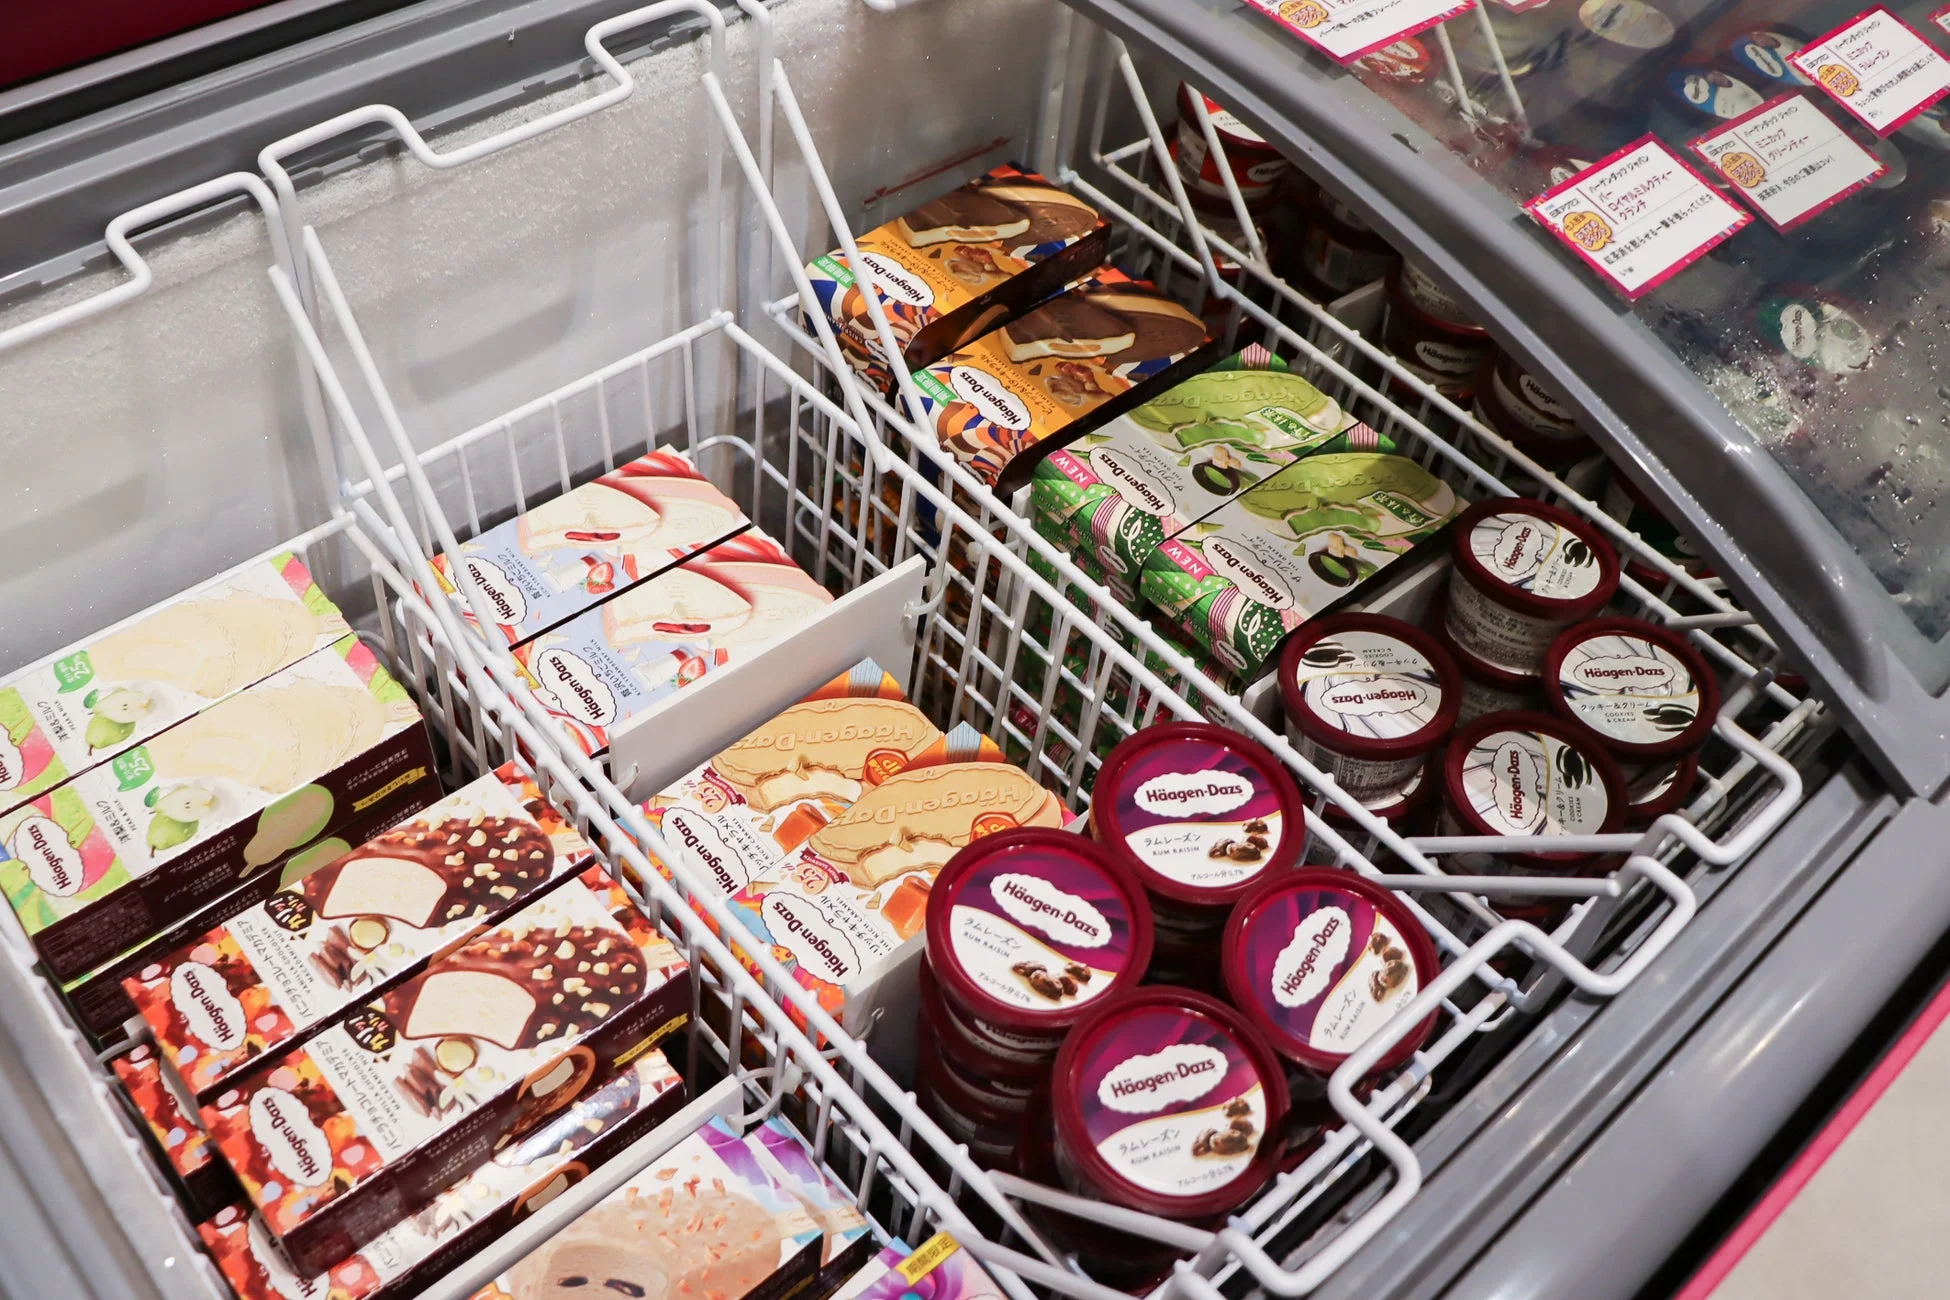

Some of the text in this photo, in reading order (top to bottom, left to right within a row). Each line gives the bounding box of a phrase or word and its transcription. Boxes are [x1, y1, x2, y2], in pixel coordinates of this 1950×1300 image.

[1755, 127, 1787, 150] ミニカップ
[1768, 134, 1810, 162] グリーンティー
[1607, 168, 1674, 213] ロイヤルミルクティー
[1618, 198, 1648, 222] クランチ
[816, 255, 853, 286] 期間限定
[861, 254, 926, 304] Häagen-Dazs
[913, 370, 951, 402] 期間限定
[958, 369, 1023, 426] Häagen-Dazs
[1054, 453, 1088, 484] NEW
[1097, 451, 1166, 512] Häagen-Dazs
[1166, 544, 1203, 576] NEW
[1239, 531, 1303, 584] ザ・グリーンティー
[1503, 527, 1531, 569] Häagen-Dazs
[466, 562, 516, 622] Häagen-Dazs
[497, 551, 542, 601] 贅沢いちごミルク
[1211, 542, 1284, 605] Häagen-Dazs
[66, 654, 90, 679] 25%
[548, 655, 605, 722] Häagen-Dazs
[582, 644, 633, 700] 贅沢いちごミルク
[589, 638, 641, 696] RICH STRAWBERRY MILK
[1584, 667, 1665, 679] Häagen-Dazs
[1332, 689, 1417, 704] Häagen-Dazs
[1580, 701, 1652, 712] クッキー&クリーム
[37, 698, 70, 743] 洋梨&ミルク
[125, 749, 151, 776] 25%
[1510, 750, 1521, 820] Häagen-Dazs
[1146, 784, 1243, 803] Häagen-Dazs
[96, 797, 131, 845] 洋梨&ミルク
[732, 817, 769, 861] RICH CARAMEL
[1144, 833, 1201, 847] ラムレーズン
[25, 824, 73, 890] Häagen-Dazs
[669, 813, 739, 895] Häagen-Dazs
[1173, 845, 1200, 854] RAISIN
[268, 898, 308, 930] カリッ!
[835, 896, 892, 951] THE RICH CARAMEL
[1002, 880, 1099, 937] Häagen-Dazs
[273, 928, 315, 983] MACADAMIA NUT
[771, 900, 849, 978] Häagen-Dazs
[963, 931, 1010, 959] RUM RAISIN
[964, 916, 1023, 950] ラムレーズン
[236, 917, 314, 1021] バニラチョコレートマカデミア
[261, 926, 312, 995] VANILLA CHOCOLATE
[1280, 917, 1340, 996] Häagen-Dazs
[181, 970, 236, 1043] Häagen-Dazs
[1323, 989, 1357, 1038] ラムレーズン
[1340, 1002, 1366, 1040] RUM RAISIN
[348, 1014, 391, 1052] カリッ!
[315, 1036, 402, 1152] バニラチョコレートマカデミア
[342, 1047, 400, 1124] VANILLA CHOCOLATE
[355, 1050, 401, 1111] MACADAMIA NUT
[1110, 1058, 1215, 1098] Häagen-Dazs
[260, 1096, 322, 1178] Häagen-Dazs
[1119, 1128, 1181, 1155] ラムレーズン
[1130, 1145, 1181, 1165] RUM RAISIN
